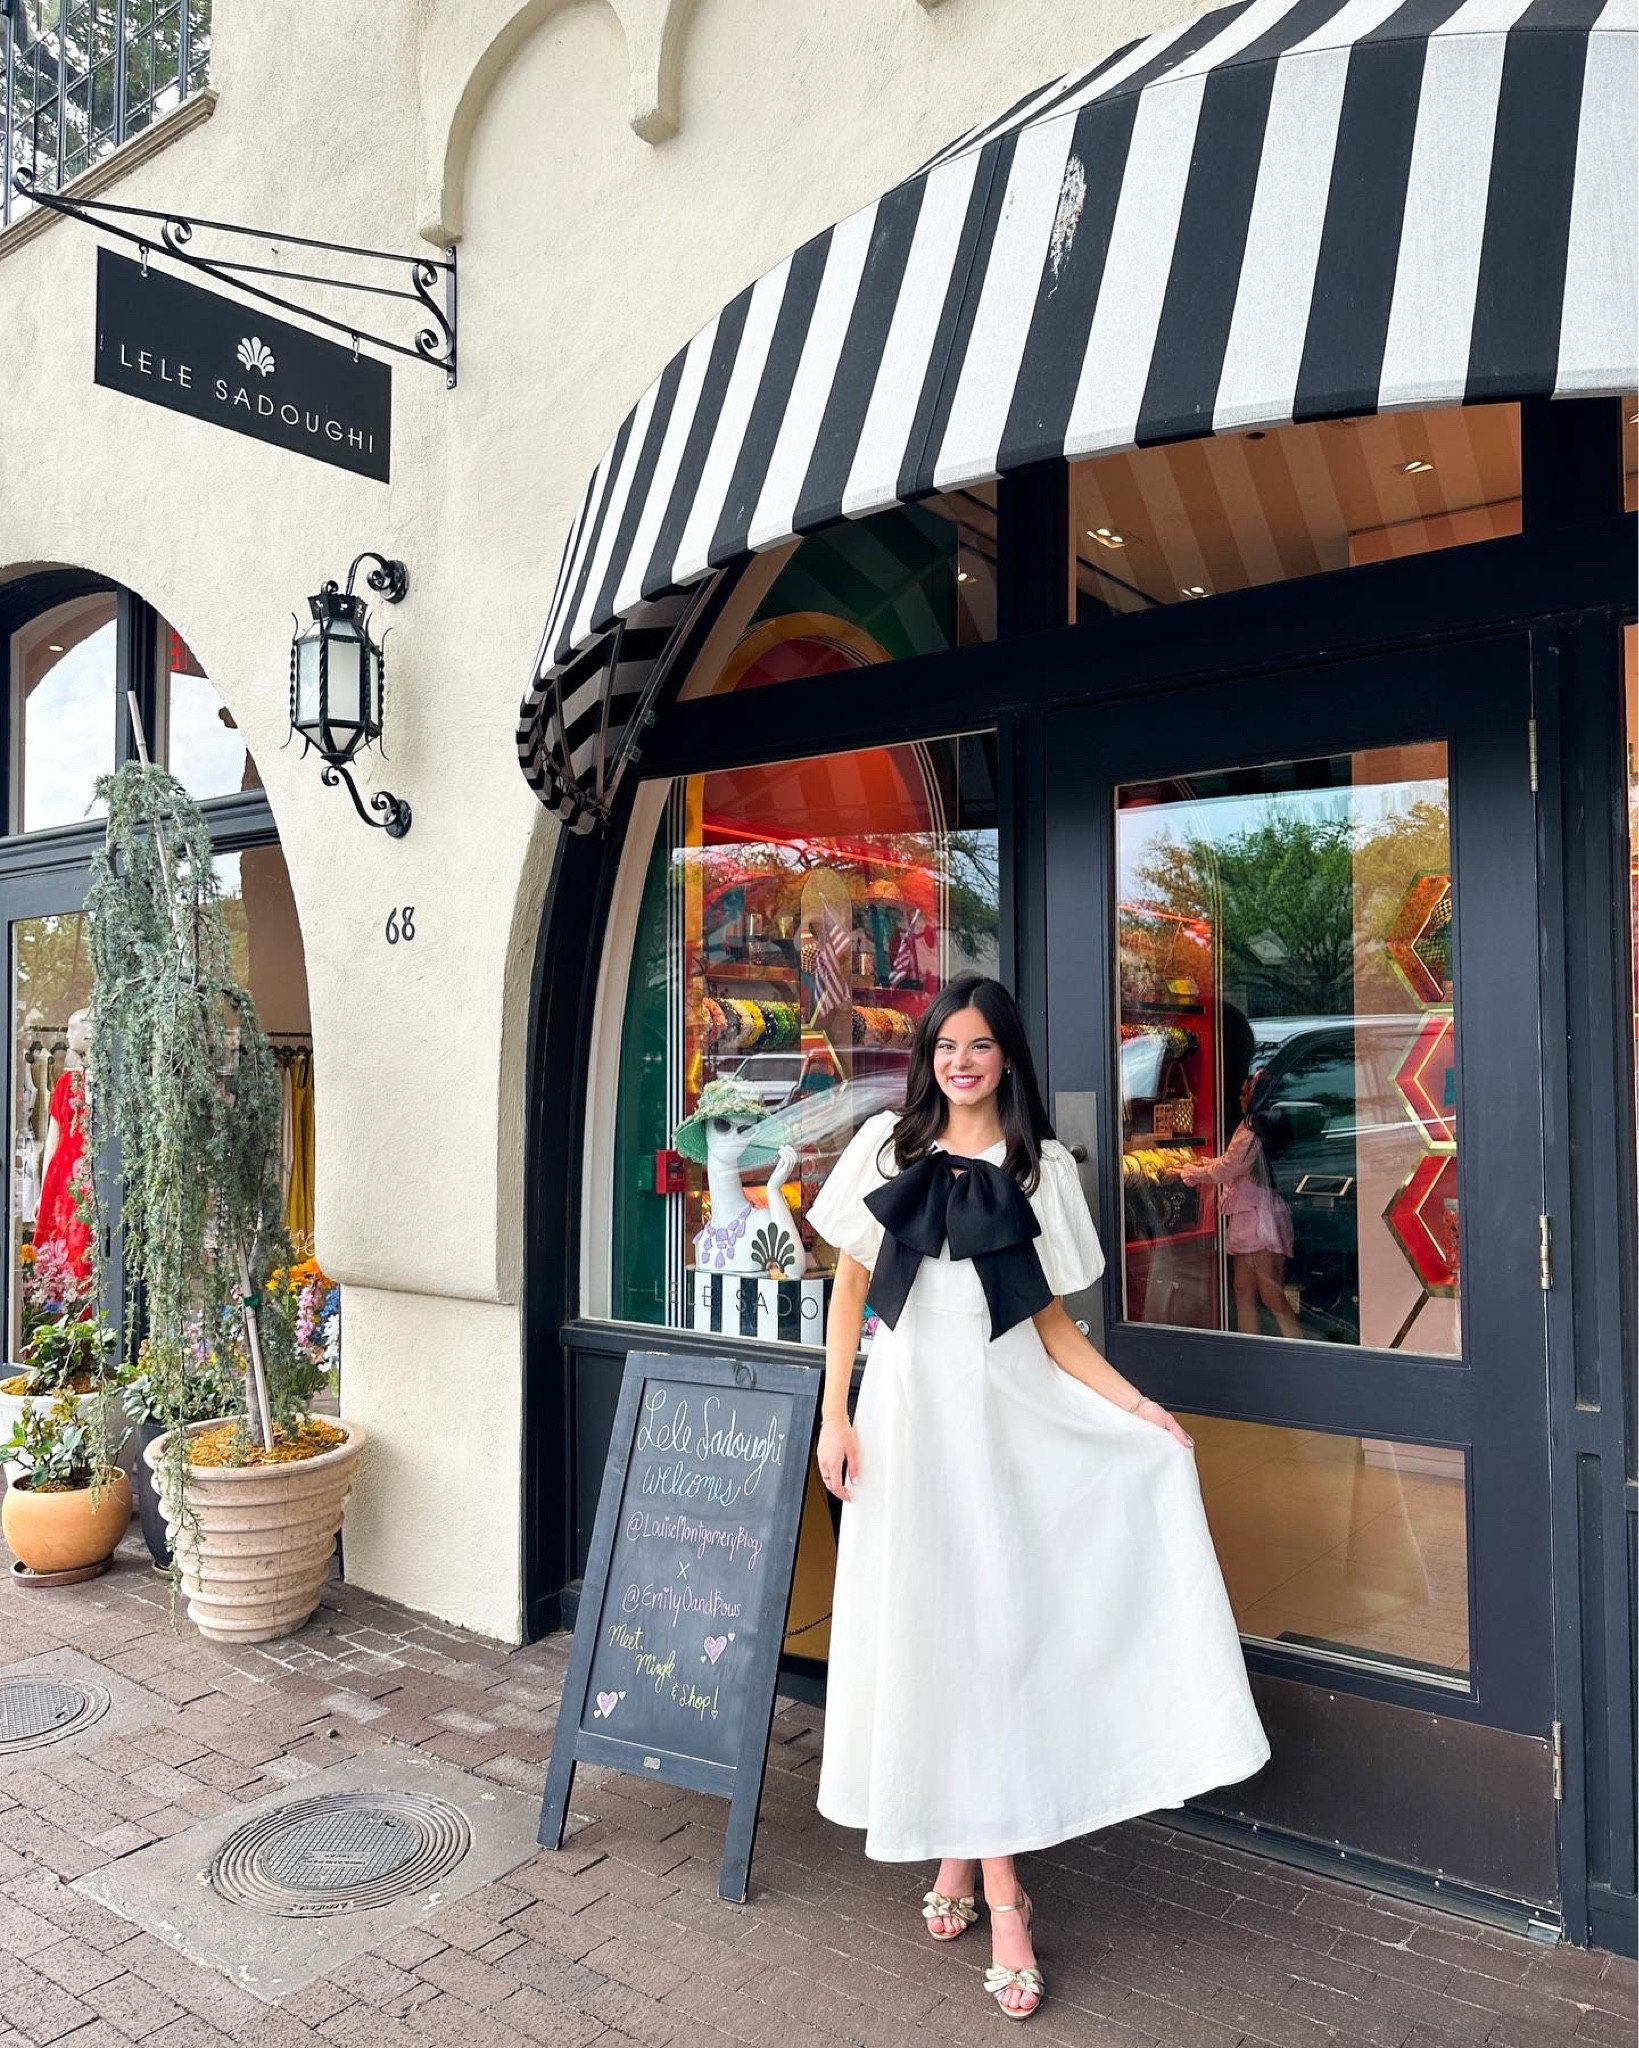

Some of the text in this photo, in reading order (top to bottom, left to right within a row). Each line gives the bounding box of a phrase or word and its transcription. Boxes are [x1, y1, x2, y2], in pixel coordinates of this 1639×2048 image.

[120, 343, 375, 454] LELE SADOUGHI
[385, 906, 416, 945] 68
[735, 1288, 820, 1321] SADO
[637, 1388, 786, 1496] Lele Sadoughi
